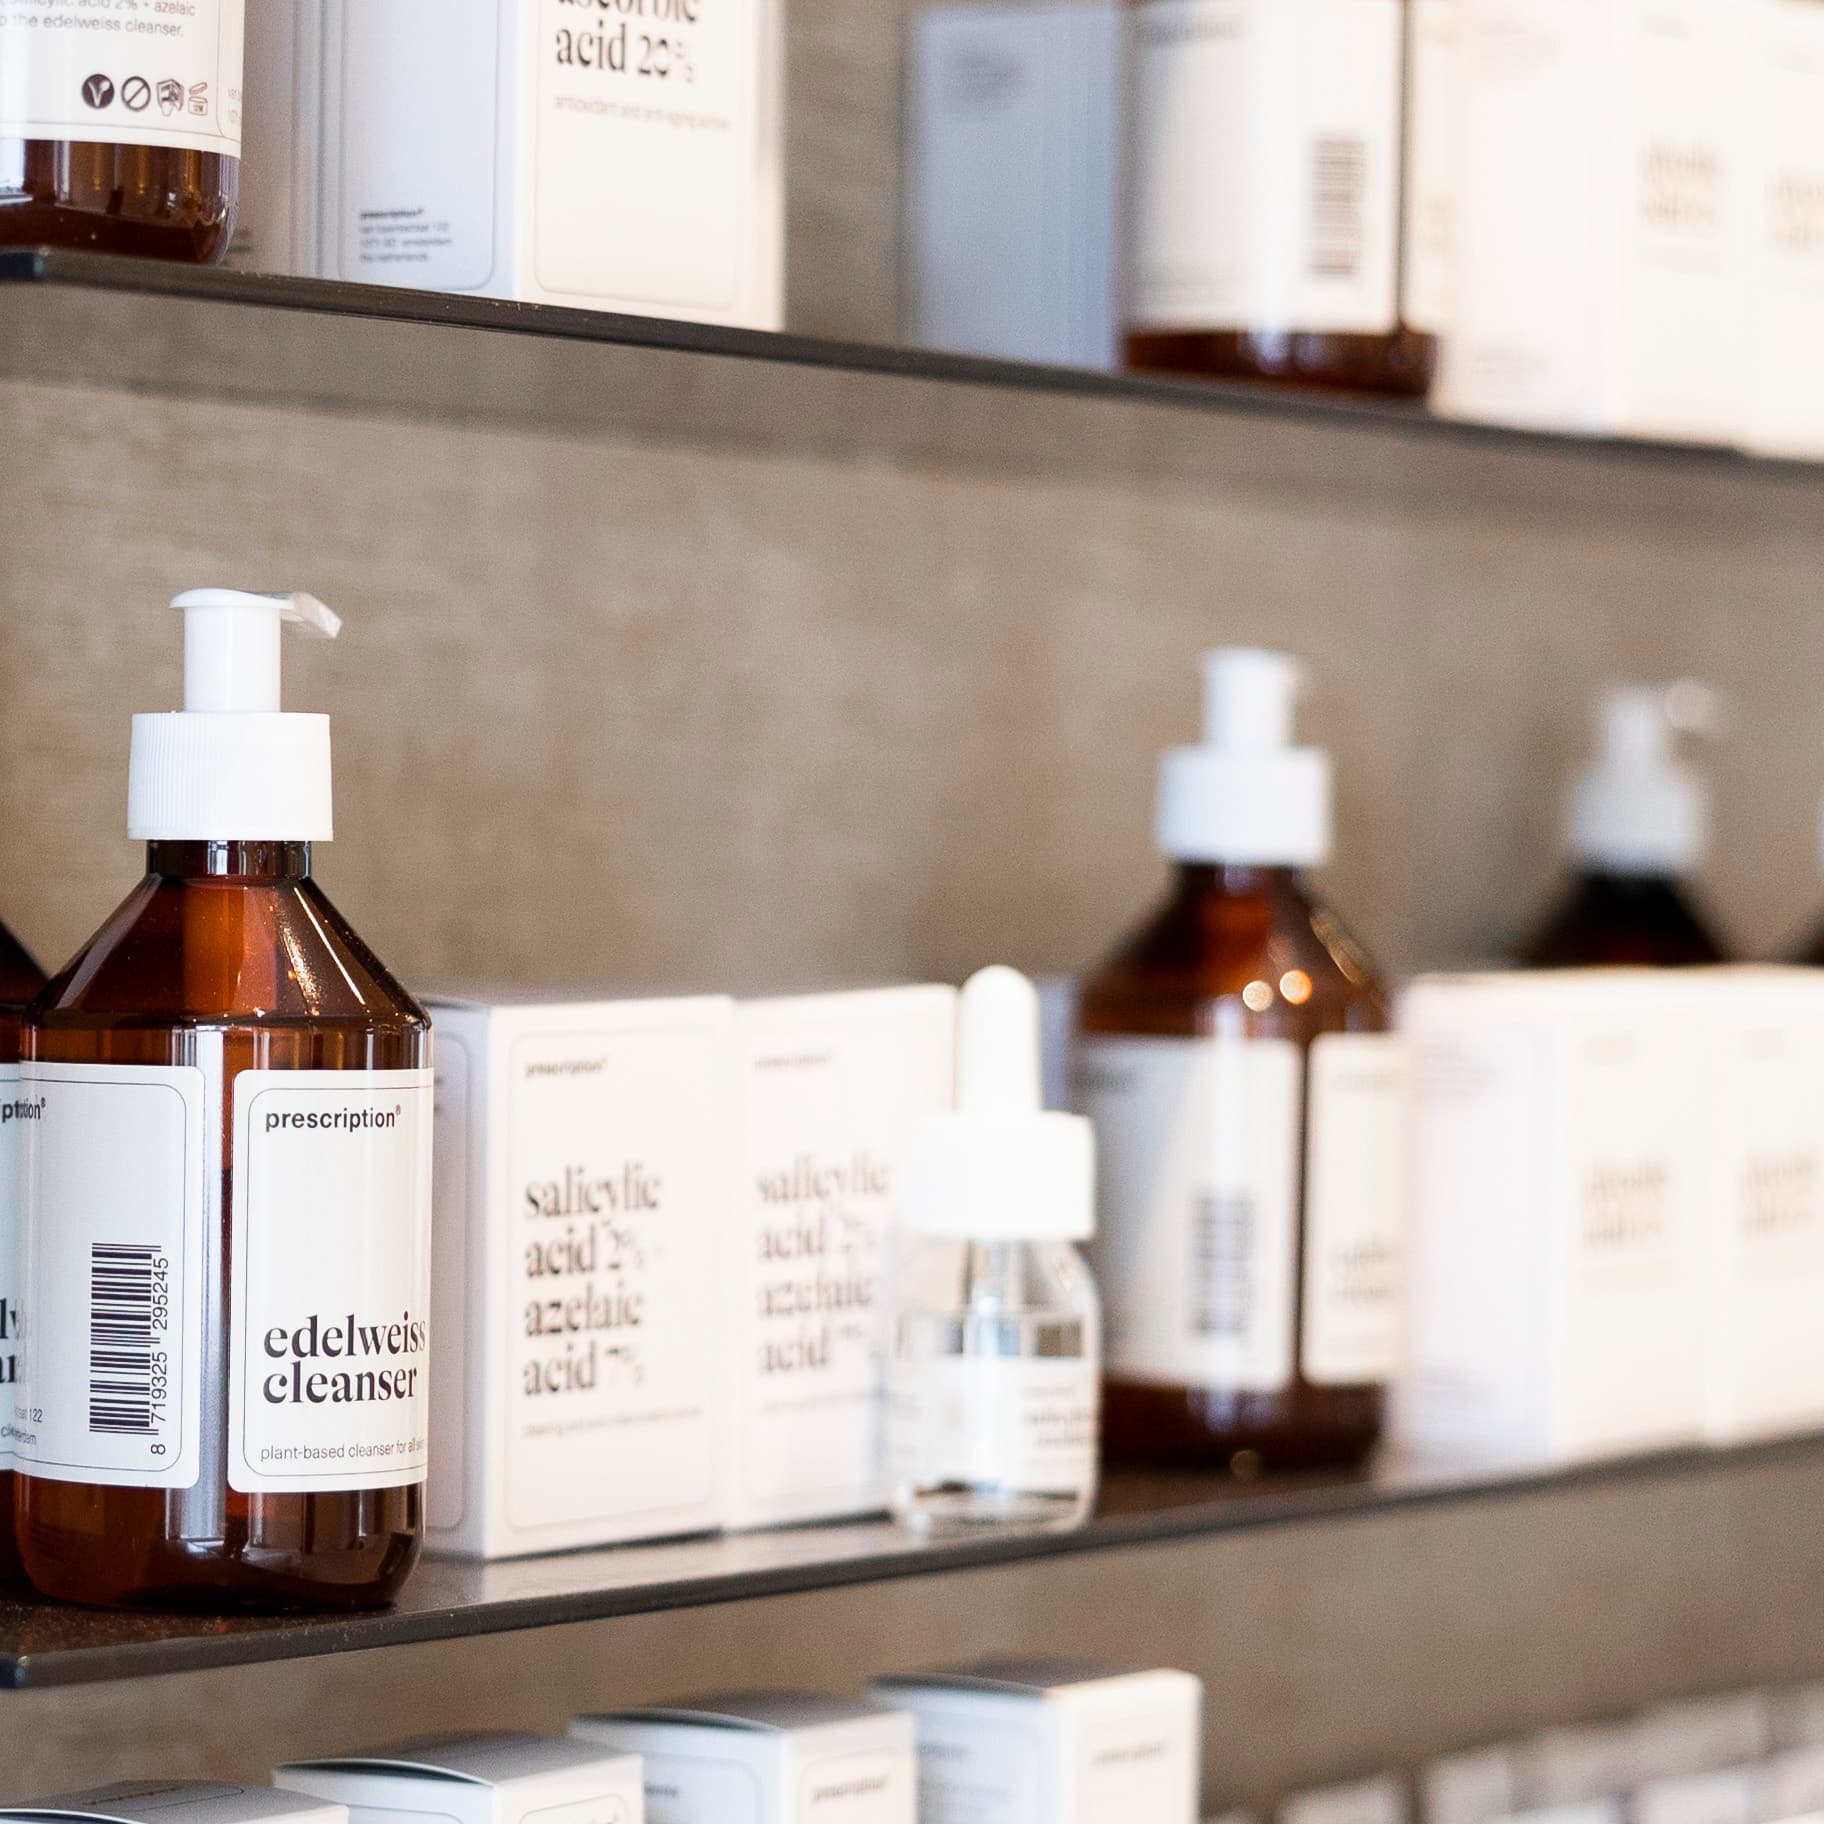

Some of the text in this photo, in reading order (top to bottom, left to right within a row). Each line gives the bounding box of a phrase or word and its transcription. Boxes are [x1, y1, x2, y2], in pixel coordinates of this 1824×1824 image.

[556, 18, 628, 74] acid
[525, 1161, 662, 1222] salicylic
[525, 1221, 597, 1278] acid
[263, 1310, 426, 1358] edelweiss
[525, 1280, 644, 1337] azelaic
[150, 1257, 169, 1456] 8 719325 295245
[262, 1360, 419, 1404] cleanser
[523, 1339, 597, 1396] acid
[260, 1440, 395, 1463] plant-based cleanser
